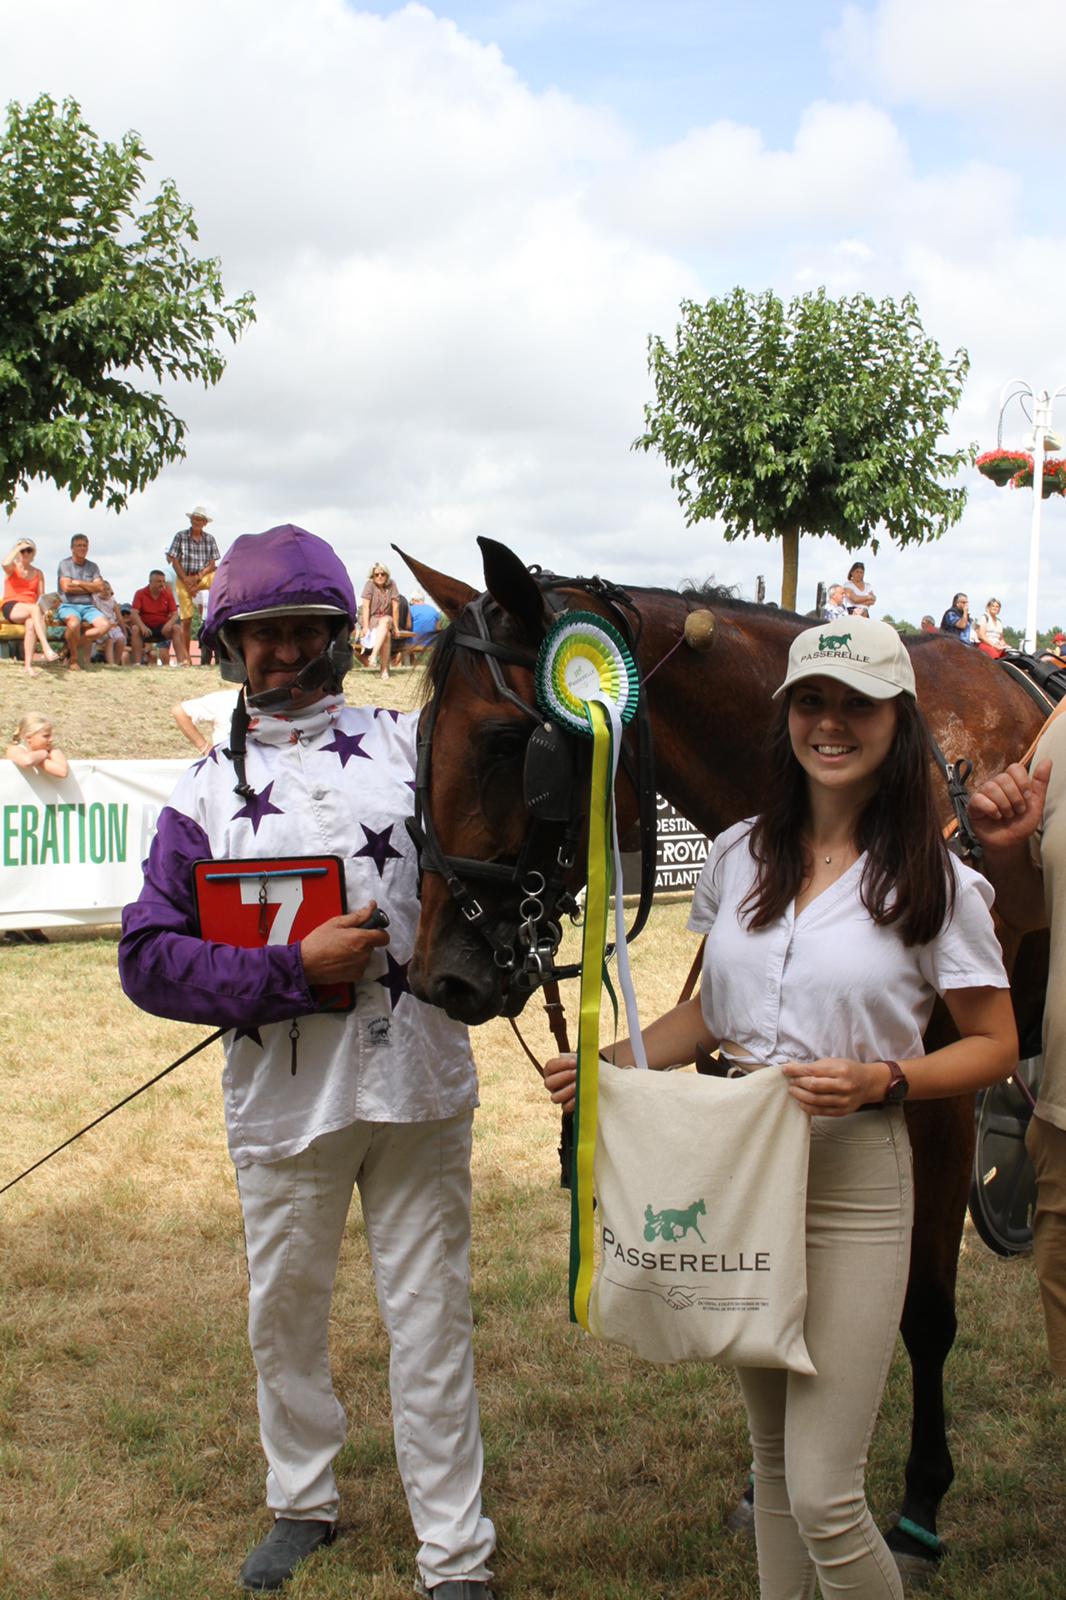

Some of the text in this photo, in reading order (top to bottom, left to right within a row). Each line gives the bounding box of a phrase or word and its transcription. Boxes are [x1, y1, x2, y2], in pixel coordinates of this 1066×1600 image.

[801, 650, 870, 663] PASSERELLE
[3, 802, 129, 867] ERATION
[239, 876, 304, 946] 7
[602, 1226, 771, 1272] PASSERELLE
